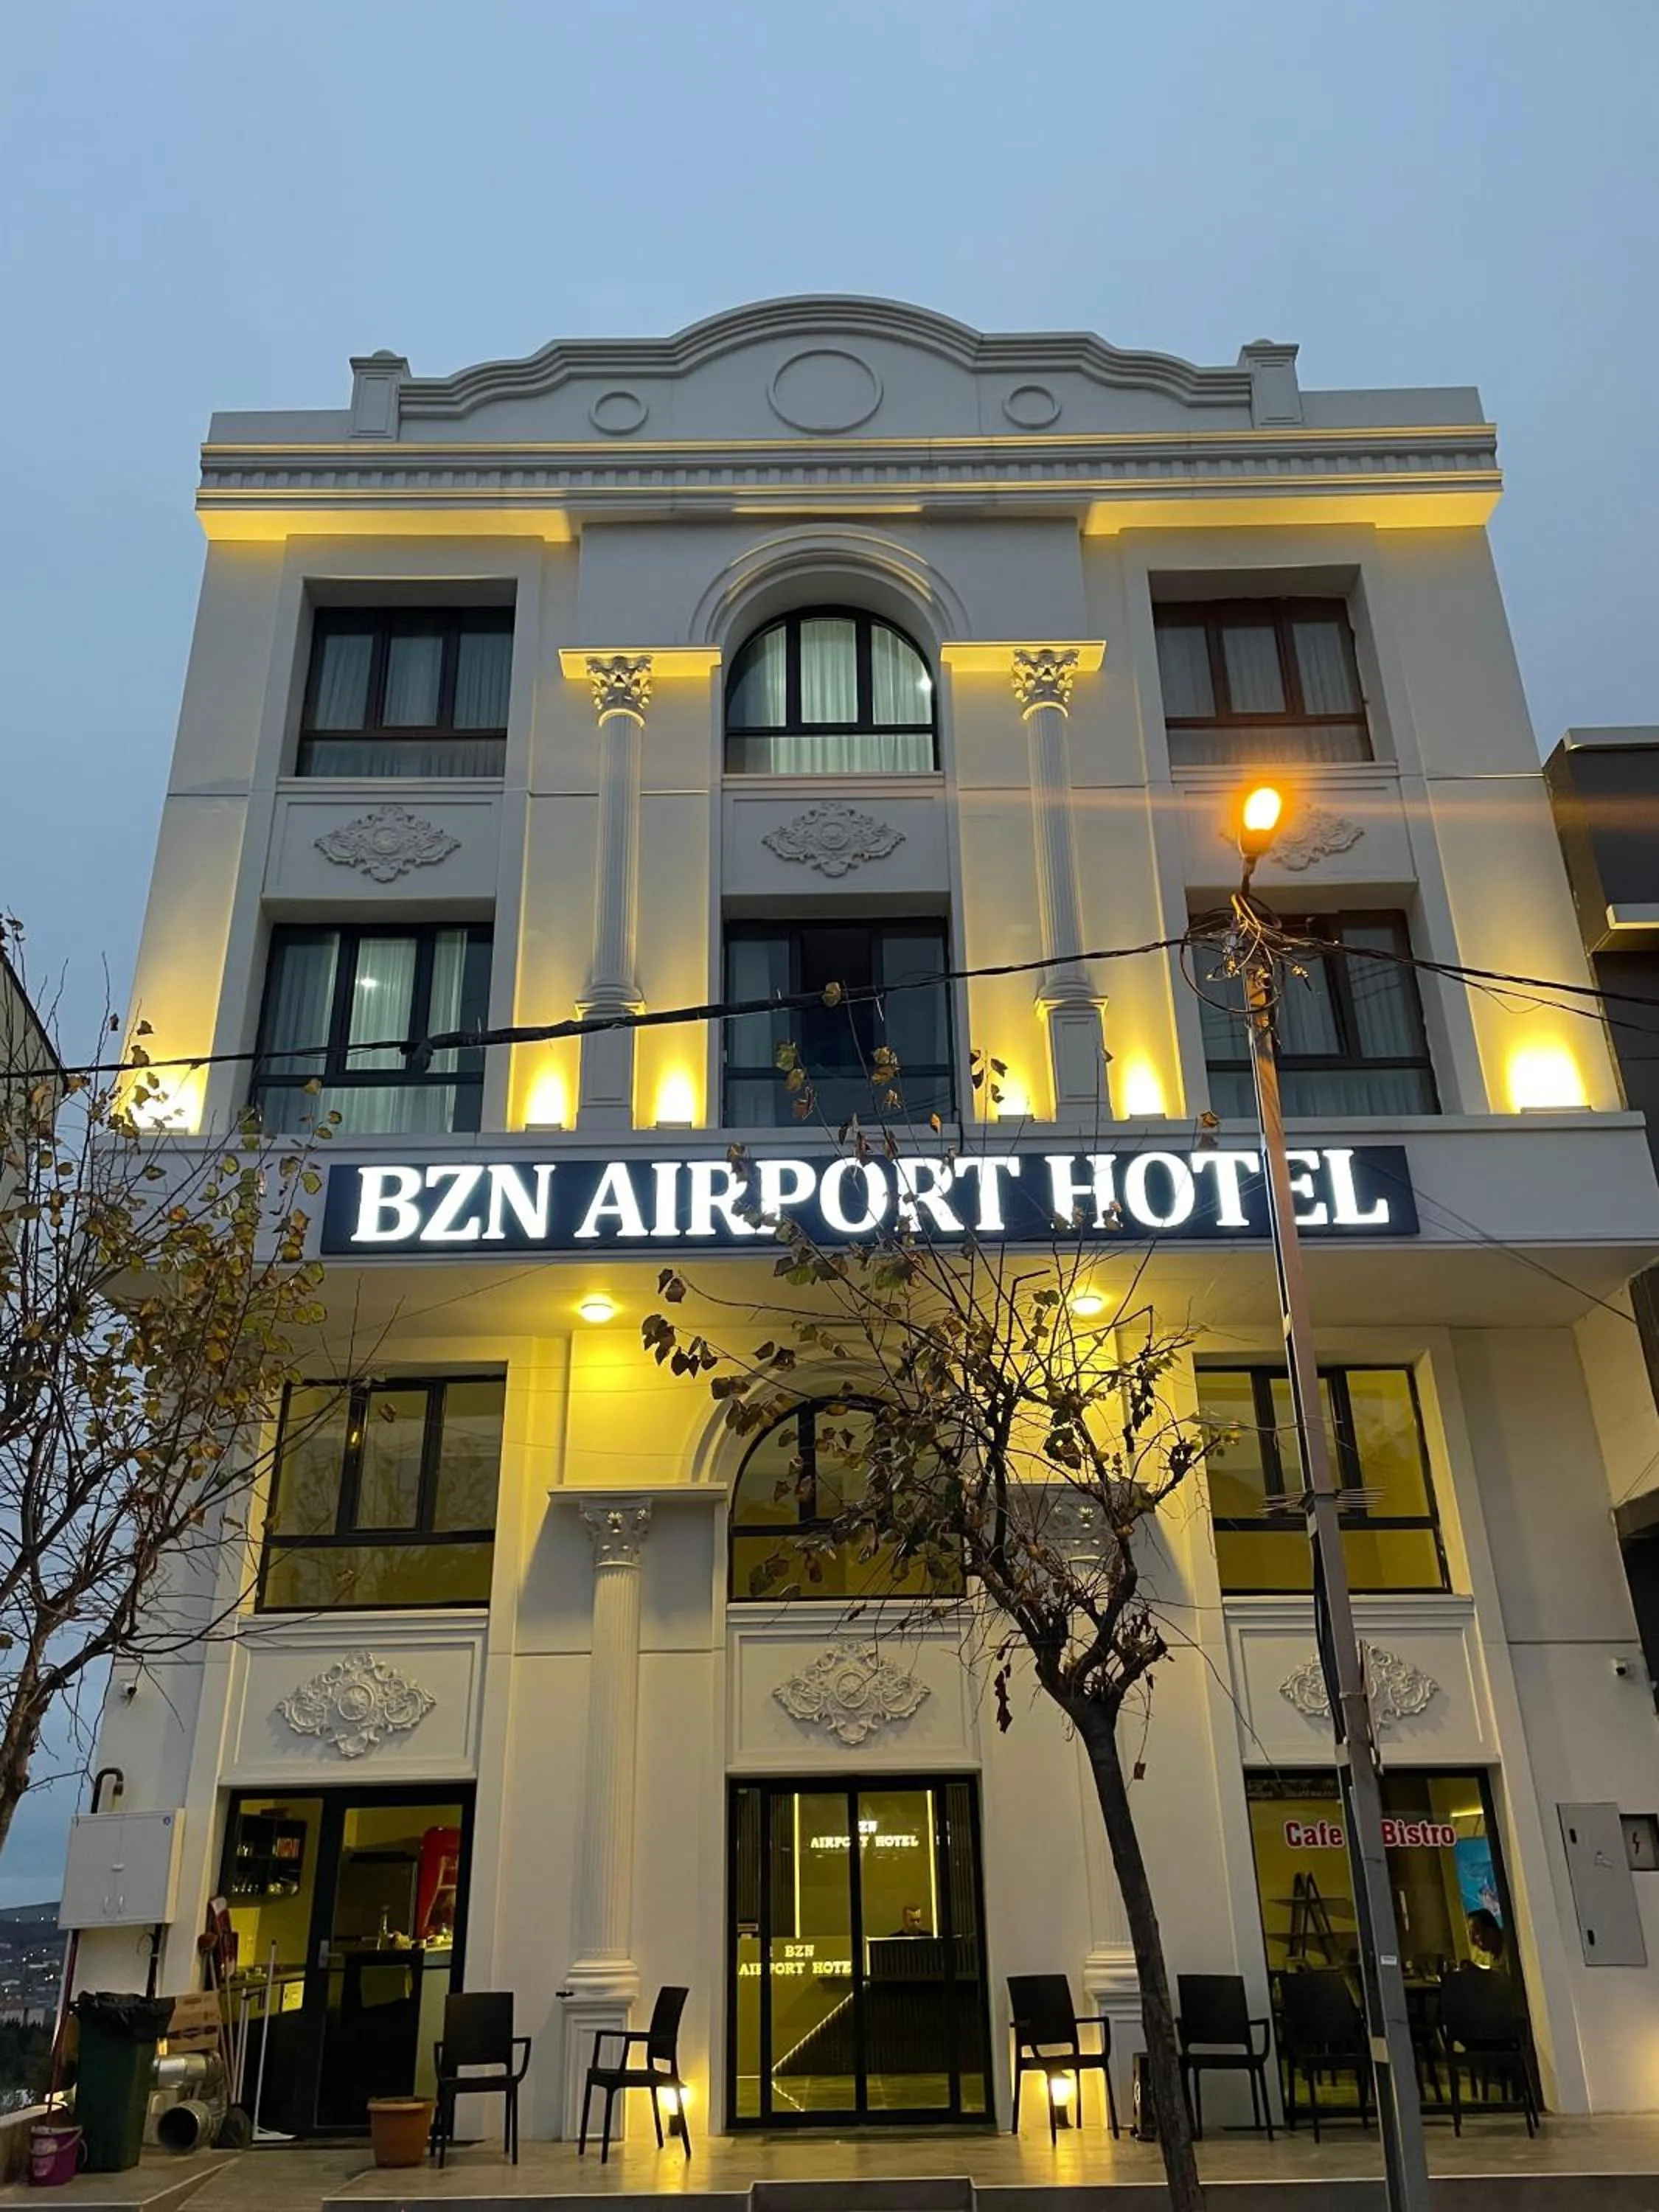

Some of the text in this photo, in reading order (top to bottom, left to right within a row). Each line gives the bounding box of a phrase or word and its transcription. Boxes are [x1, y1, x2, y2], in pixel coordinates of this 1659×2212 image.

[349, 1149, 1389, 1242] BZN AIRPORT HOTEL
[858, 1820, 877, 1833] ZN
[1284, 1820, 1456, 1848] Cafe Bistro
[811, 1835, 919, 1848] AIRPOT HOTEL
[785, 1945, 814, 1958] BZN
[812, 1961, 852, 1974] HOTE
